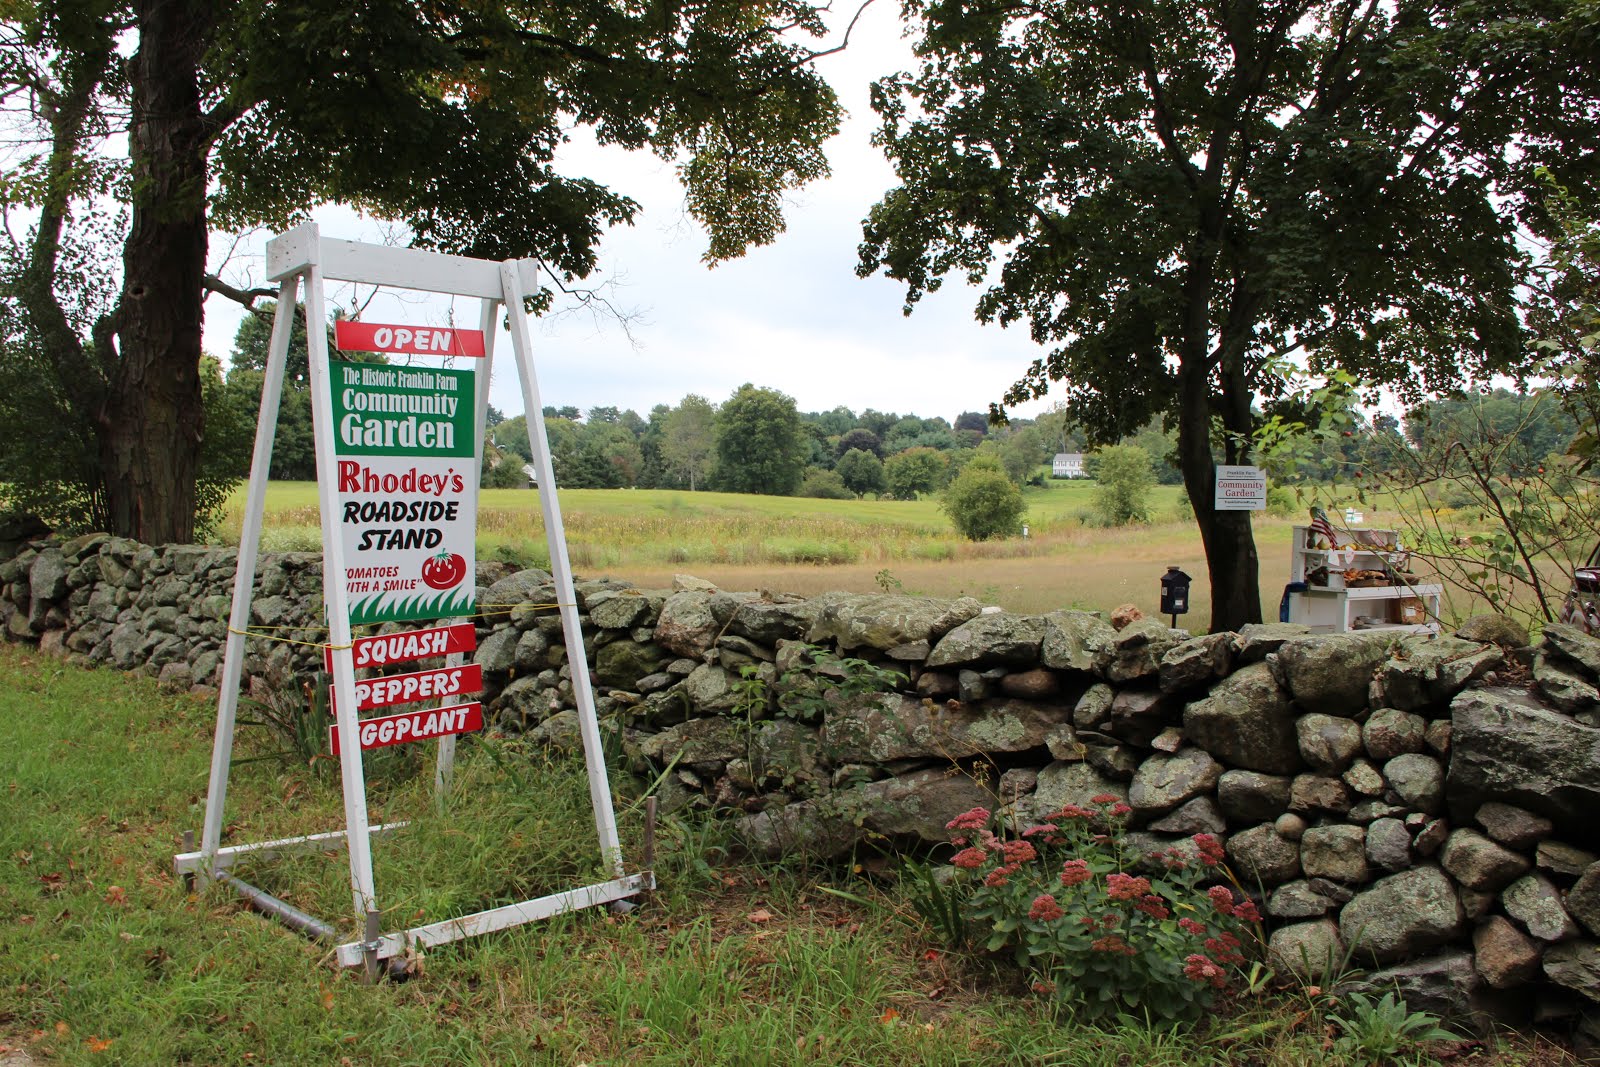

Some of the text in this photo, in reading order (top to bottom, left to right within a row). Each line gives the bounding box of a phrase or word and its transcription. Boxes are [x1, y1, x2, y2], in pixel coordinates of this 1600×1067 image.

[374, 327, 451, 351] OPEN
[343, 367, 458, 391] The Historic Franklin Farm
[342, 388, 458, 417] Community
[340, 413, 455, 448] Garden
[338, 460, 464, 496] Rhodey's
[1218, 481, 1263, 490] Community
[1225, 489, 1256, 497] Garden
[343, 501, 459, 524] ROADSIDE
[358, 528, 443, 551] STAND
[345, 566, 399, 579] OMATOES
[373, 580, 380, 592] A
[357, 630, 449, 665] SQUASH
[355, 670, 462, 707] PEPPERS
[358, 708, 470, 746] GGPLANT
